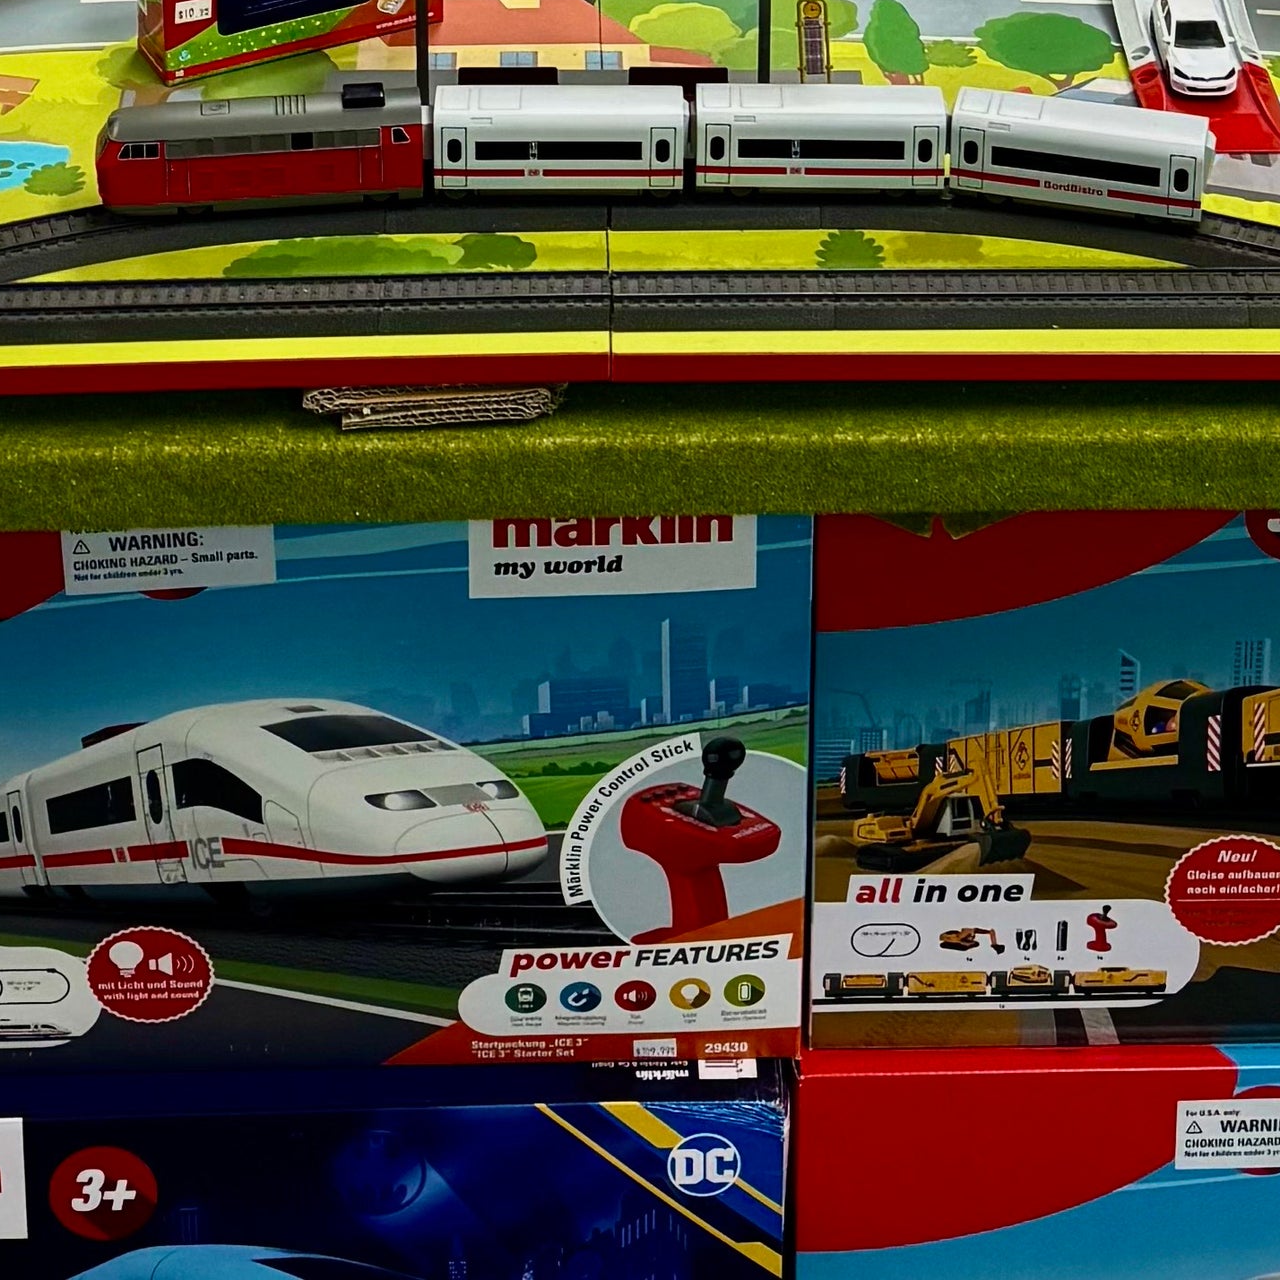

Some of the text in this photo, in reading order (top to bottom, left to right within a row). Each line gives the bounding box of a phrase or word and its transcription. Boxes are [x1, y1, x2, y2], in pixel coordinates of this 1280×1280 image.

[1044, 181, 1103, 195] BordBistro
[108, 532, 204, 552] WARNING:
[73, 549, 258, 571] CHOKING HAZARD Small parts.
[493, 554, 624, 579] my world
[564, 739, 694, 898] Märklin Power Control Stick
[193, 837, 223, 870] ICE
[1217, 850, 1258, 863] Neu!
[855, 878, 1025, 904] all in one
[510, 941, 780, 979] power FEATURES
[704, 1041, 748, 1054] 29430
[672, 1148, 738, 1186] DC
[69, 1168, 138, 1214] 3+
